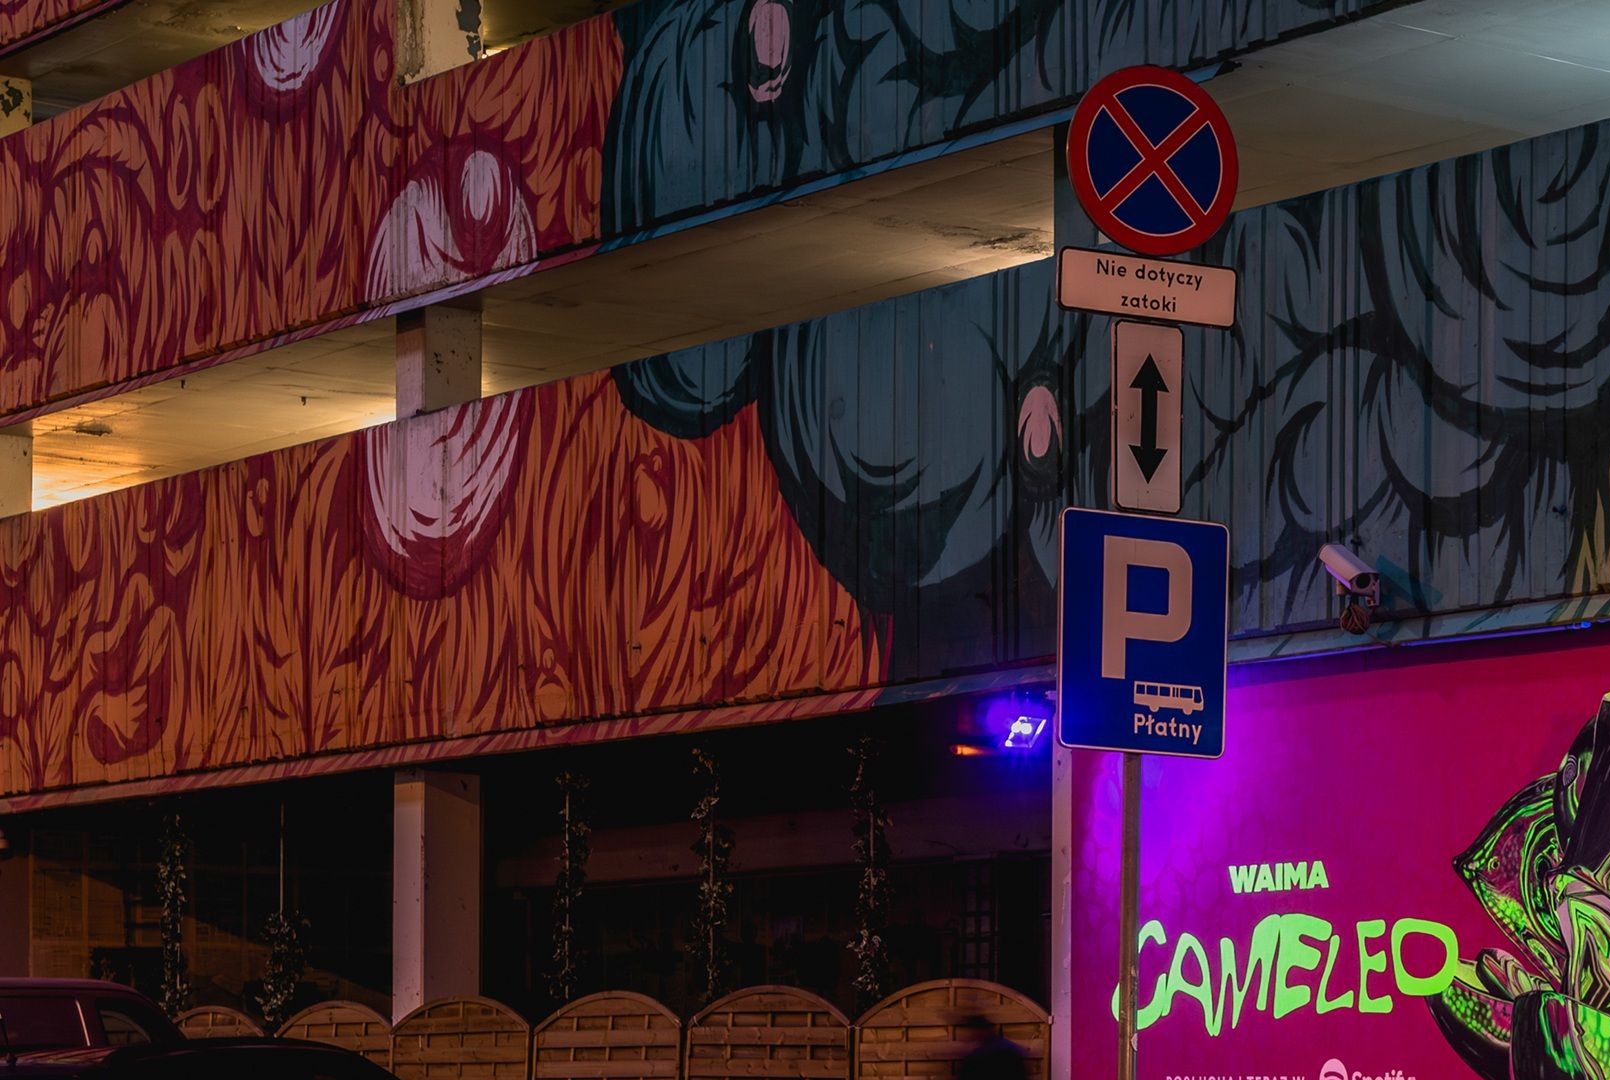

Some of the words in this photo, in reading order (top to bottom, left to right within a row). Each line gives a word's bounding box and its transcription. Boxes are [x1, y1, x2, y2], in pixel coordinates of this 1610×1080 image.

[1096, 258, 1127, 277] Nie
[1135, 264, 1203, 291] dotyczy
[1121, 294, 1177, 313] zatoki
[1101, 534, 1194, 680] P
[1133, 713, 1203, 745] Płatny
[1228, 860, 1330, 894] WAIMA
[1111, 913, 1459, 1037] CAMELEO
